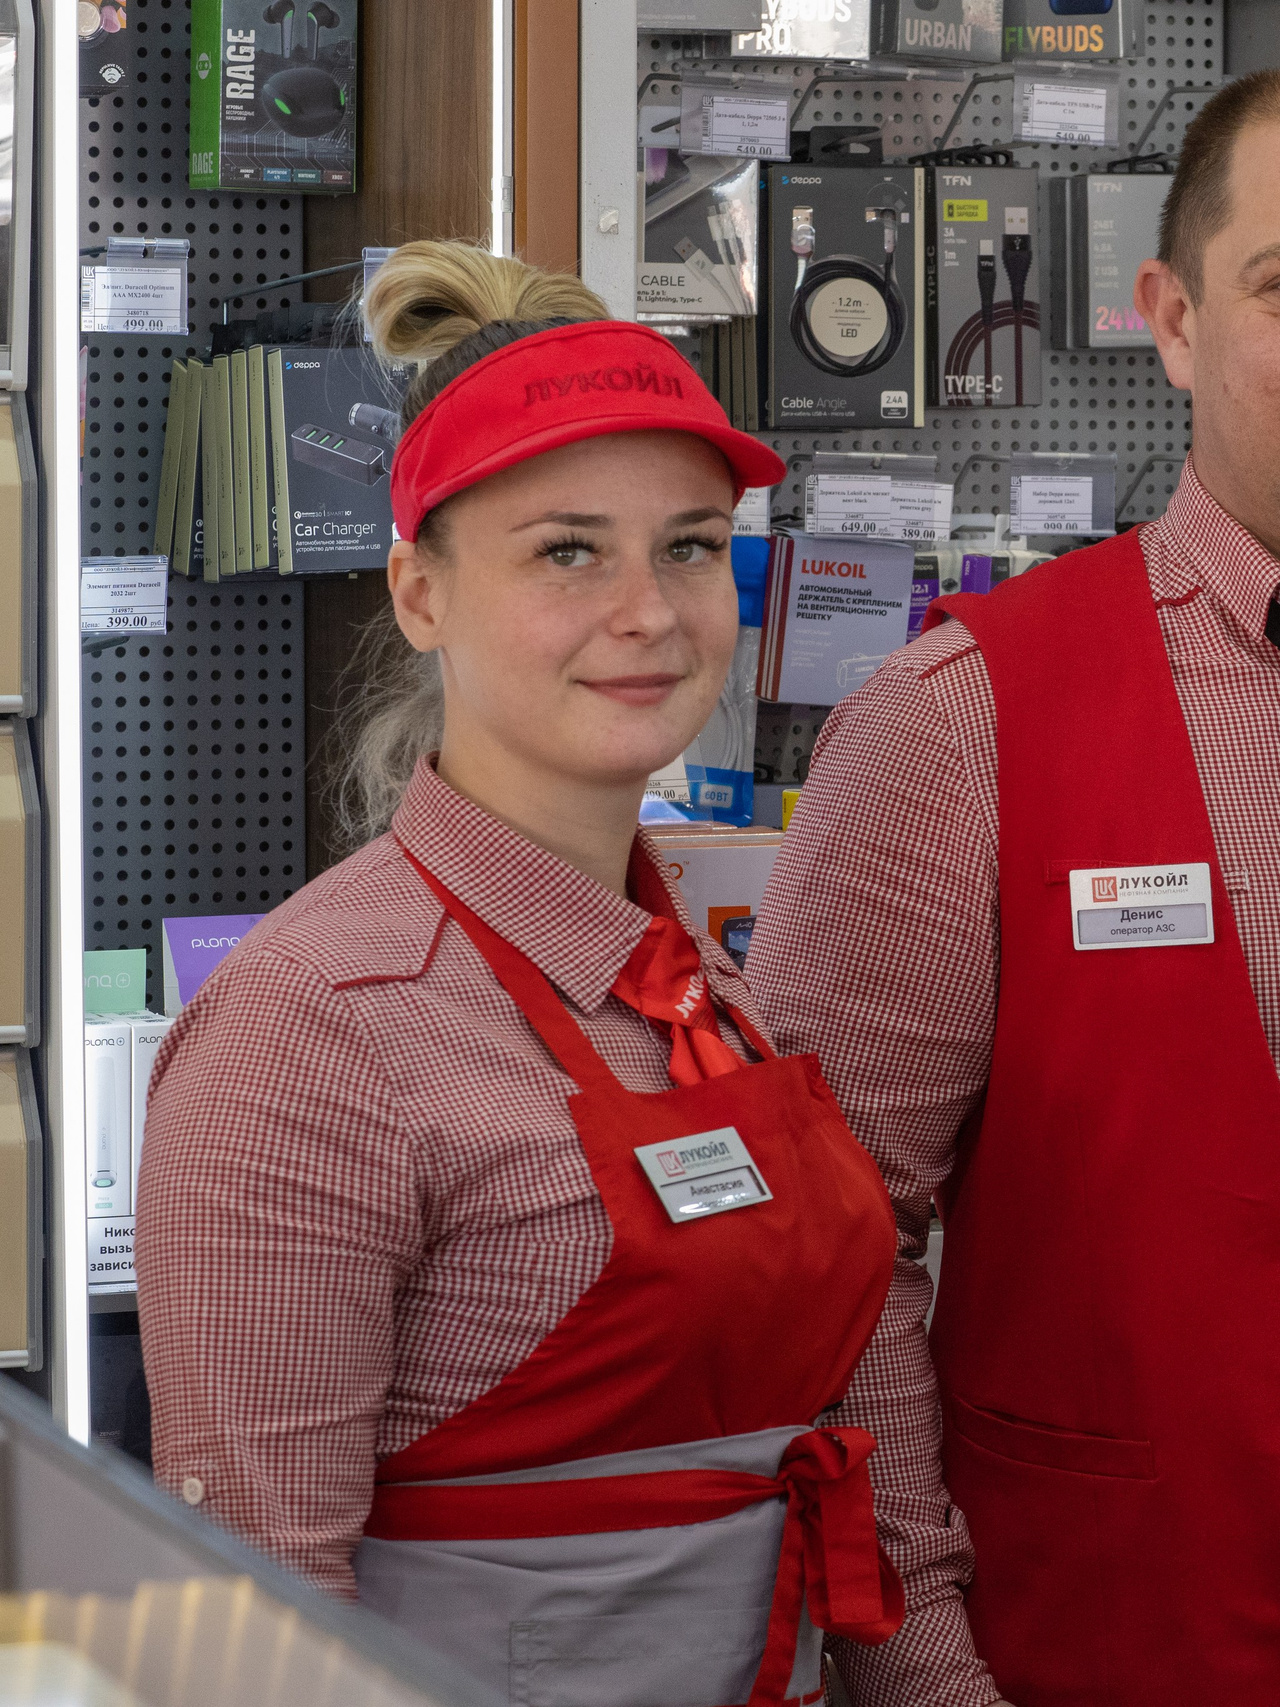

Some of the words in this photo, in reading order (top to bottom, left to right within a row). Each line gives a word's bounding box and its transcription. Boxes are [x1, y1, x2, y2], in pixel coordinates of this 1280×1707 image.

[904, 18, 973, 51] URBAN
[1004, 23, 1105, 53] FLYBUDS
[226, 28, 255, 99] RAGE
[736, 145, 772, 155] 54900
[192, 152, 214, 175] RAGE
[790, 176, 822, 185] deppa
[942, 175, 972, 187] TFN
[1093, 181, 1123, 193] TFN
[640, 275, 686, 287] CABLE
[122, 319, 164, 331] 499.00
[840, 328, 858, 338] LED
[293, 361, 321, 370] deppa
[523, 362, 684, 408] ЛУКОЙЛ
[944, 375, 1003, 394] TYPE-C
[781, 396, 814, 409] Cable
[816, 397, 847, 412] Angle
[885, 395, 903, 404] 2.4A
[294, 523, 320, 537] Car
[322, 522, 377, 538] Charger
[841, 521, 877, 533] 649.00
[1043, 522, 1079, 531] 99900
[900, 528, 936, 540] 389.00
[800, 558, 868, 579] LUKOIL
[798, 584, 873, 597] АВТОМОБИЛЬНЫЙ
[797, 593, 845, 604] ДЕРЖАТЕЛЬ
[845, 597, 851, 605] С
[851, 598, 903, 609] КРЕПЛЕНИЕМ
[796, 602, 809, 610] НА
[810, 603, 888, 616] ВЕНТИЛЯЦИОННУЮ
[106, 615, 148, 628] 399.00
[796, 611, 832, 621] РЕШЕТКУ
[1118, 872, 1189, 890] ЛУКОЙЛ
[1118, 890, 1152, 898] НЕФТЯНАЯ
[1152, 888, 1189, 896] КОМПАНИЯ
[1120, 909, 1164, 923] Денис
[1110, 926, 1154, 937] оператор
[1155, 923, 1176, 933] АЗС
[138, 1035, 166, 1044] PLON
[678, 1140, 731, 1164] ЛУКОЙЛ
[689, 1178, 745, 1197] Анастасия
[104, 1226, 136, 1239] Нико
[99, 1244, 134, 1256] вызы
[89, 1261, 137, 1273] зависи
